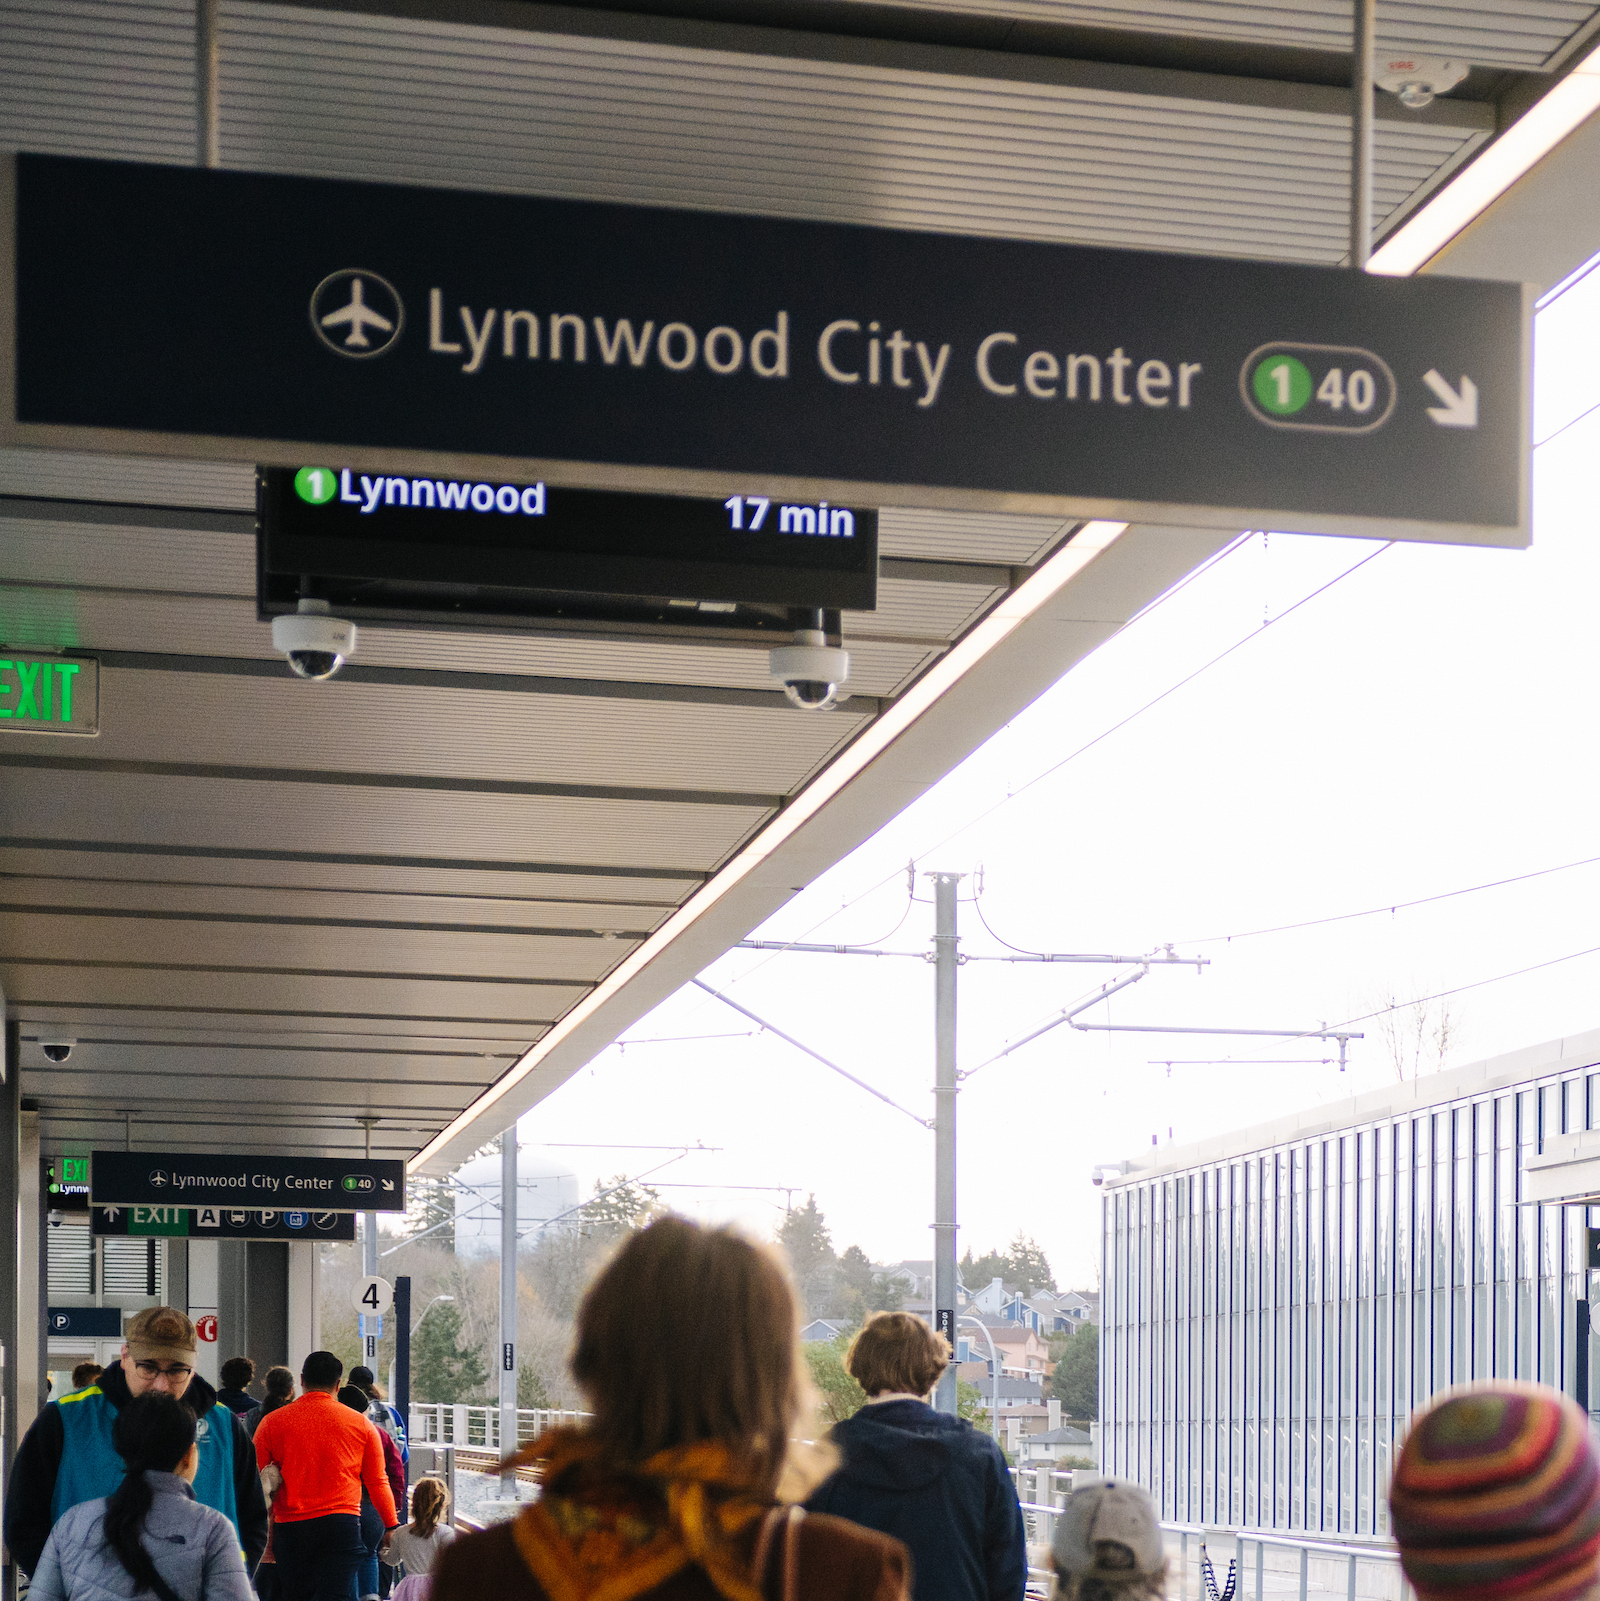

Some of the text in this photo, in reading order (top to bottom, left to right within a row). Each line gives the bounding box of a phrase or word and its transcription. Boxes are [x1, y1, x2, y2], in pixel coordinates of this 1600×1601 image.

[429, 287, 1375, 411] Lynnwood City Center 1 40
[306, 468, 854, 537] 1 Lynnwood 17 min
[0, 660, 80, 722] EXIT
[63, 1158, 88, 1182] EXI
[172, 1173, 246, 1189] Lynnwood
[252, 1174, 280, 1192] City
[284, 1176, 334, 1190] Center
[358, 1180, 371, 1188] 40
[60, 1184, 90, 1195] Lynnw
[134, 1207, 179, 1224] EXIT
[362, 1283, 380, 1310] 4
